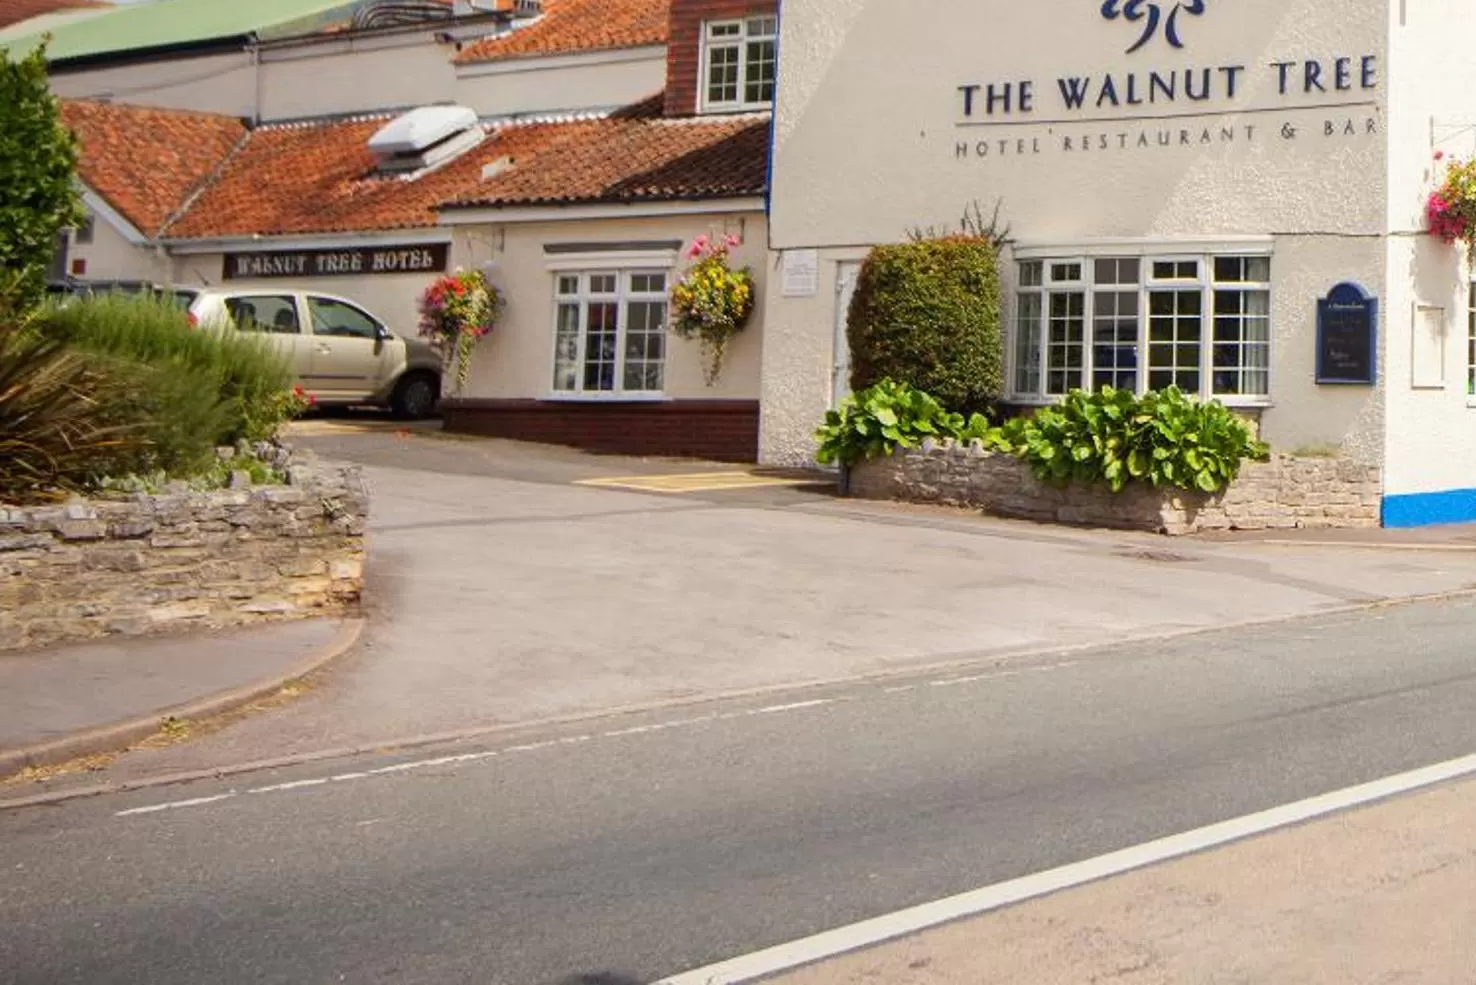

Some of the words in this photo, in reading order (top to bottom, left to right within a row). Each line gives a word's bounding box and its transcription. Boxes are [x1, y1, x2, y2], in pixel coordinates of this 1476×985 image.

[957, 80, 1033, 117] THE
[1056, 65, 1245, 111] WALNUT
[1269, 54, 1377, 95] TREE
[955, 137, 1040, 158] HOTEL
[1063, 125, 1256, 151] RESTAURANT
[1280, 122, 1296, 140] &
[1324, 117, 1377, 137] BAR
[236, 254, 308, 275] WALNUT
[316, 253, 362, 272] TREE
[372, 250, 433, 271] HOTEL
